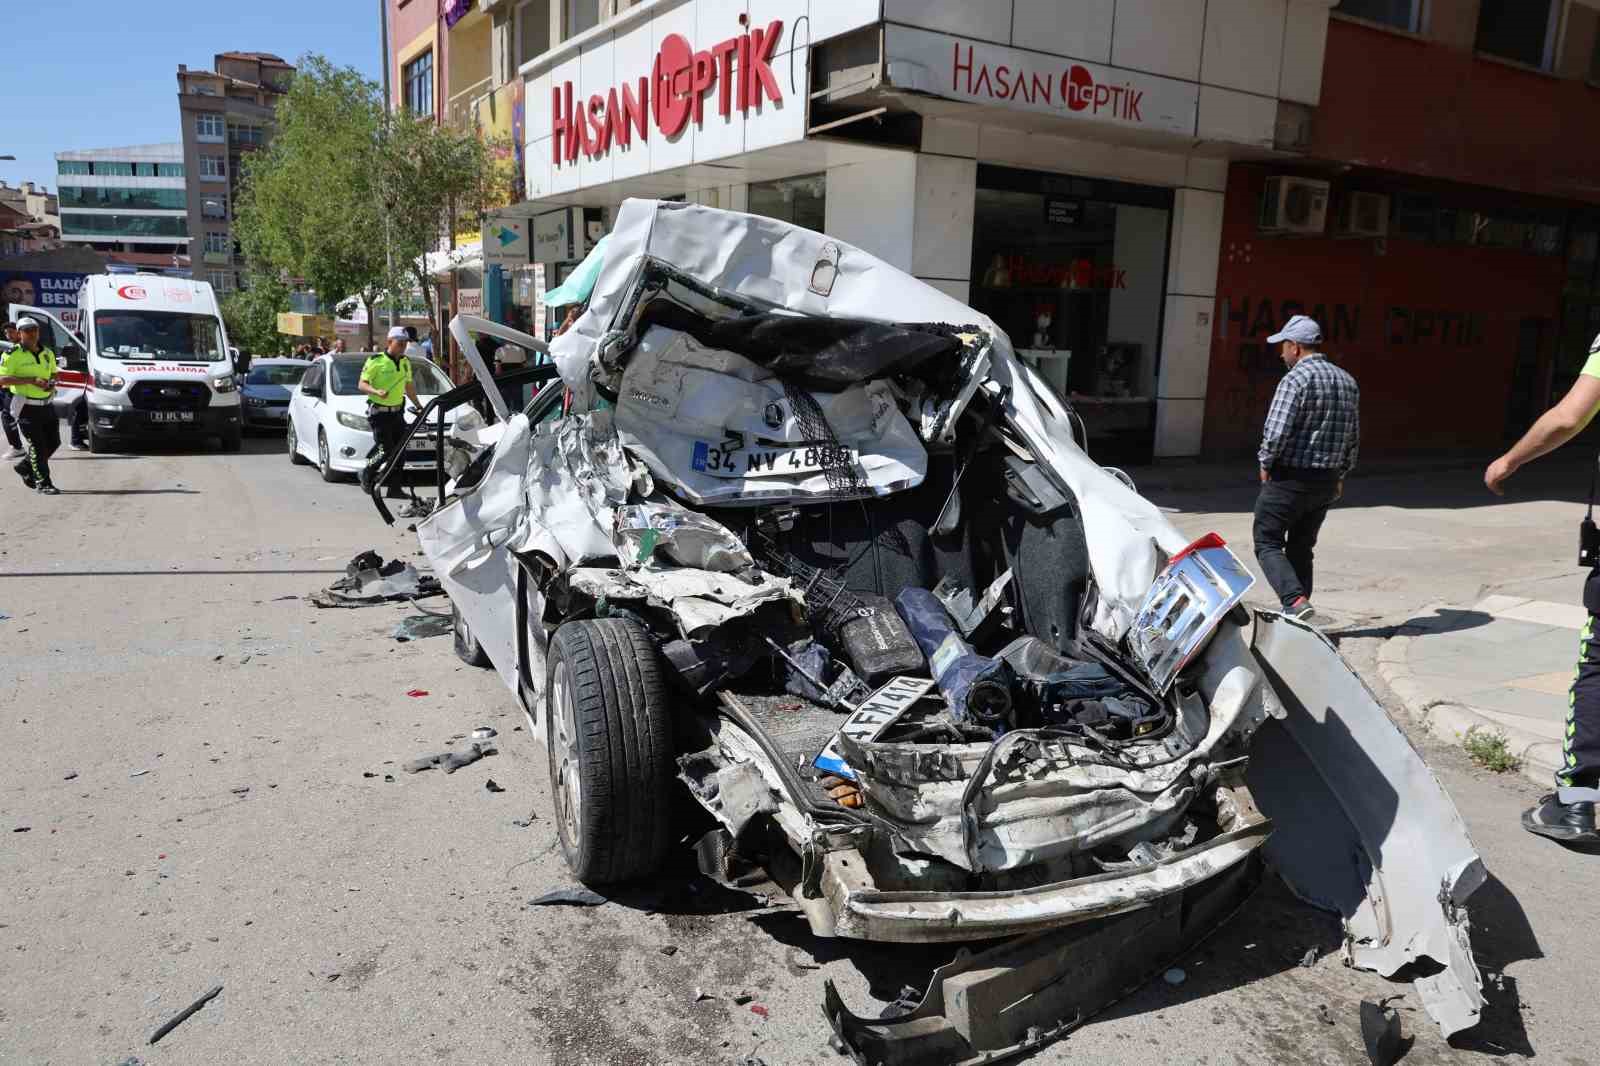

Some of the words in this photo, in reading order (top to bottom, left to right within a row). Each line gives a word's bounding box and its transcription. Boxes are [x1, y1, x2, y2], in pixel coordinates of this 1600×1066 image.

[953, 42, 1052, 104] HASAN
[552, 77, 649, 166] HASAN
[707, 448, 737, 474] 34
[747, 452, 777, 473] NV
[850, 701, 900, 725] FM
[880, 678, 930, 703] 414
